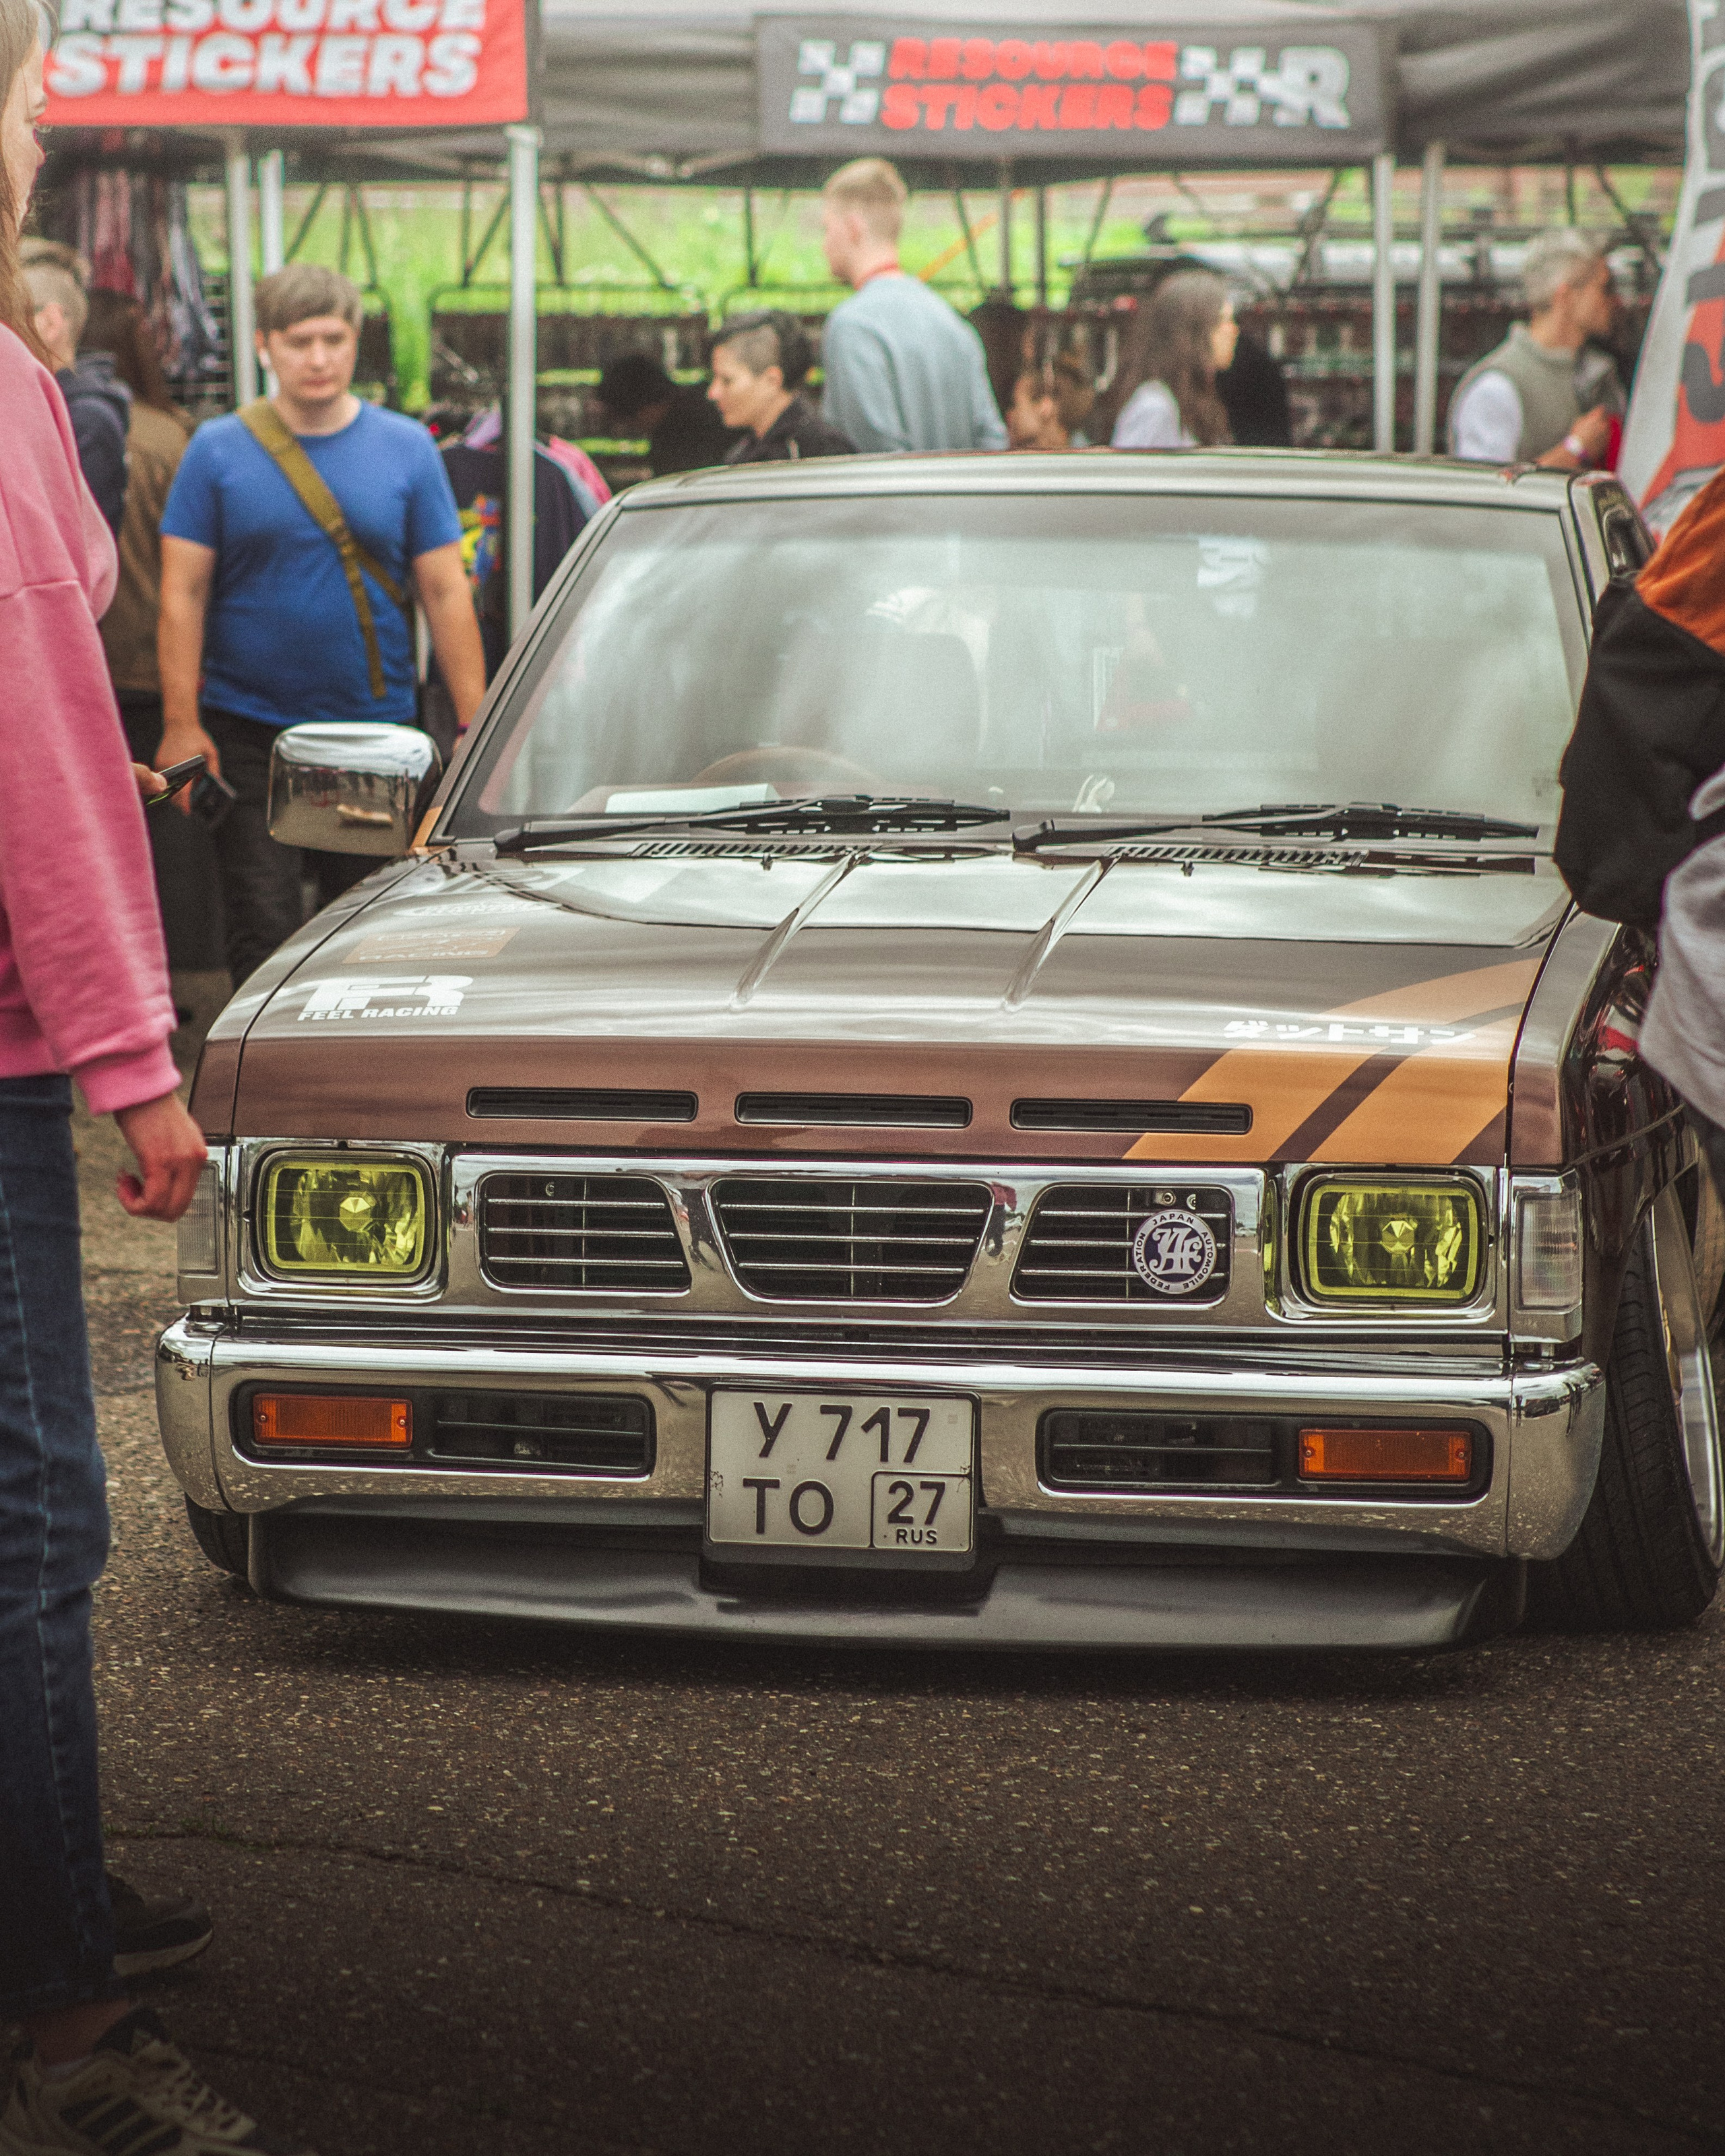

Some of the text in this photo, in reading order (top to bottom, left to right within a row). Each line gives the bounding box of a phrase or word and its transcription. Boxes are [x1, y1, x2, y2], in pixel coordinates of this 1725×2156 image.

[47, 32, 484, 98] STICKERS
[888, 38, 1178, 81] RESOURCE
[881, 82, 1174, 131] STICKERS
[297, 1006, 462, 1021] FEEL RACING
[1223, 1020, 1476, 1045] ダットサン
[1153, 1213, 1194, 1225] JAPAN
[1135, 1232, 1170, 1290] FEDERATION
[1183, 1231, 1214, 1290] AUTOMOBILE
[819, 1404, 931, 1463] 717
[887, 1480, 946, 1525] 27
[896, 1528, 937, 1544] RUS
